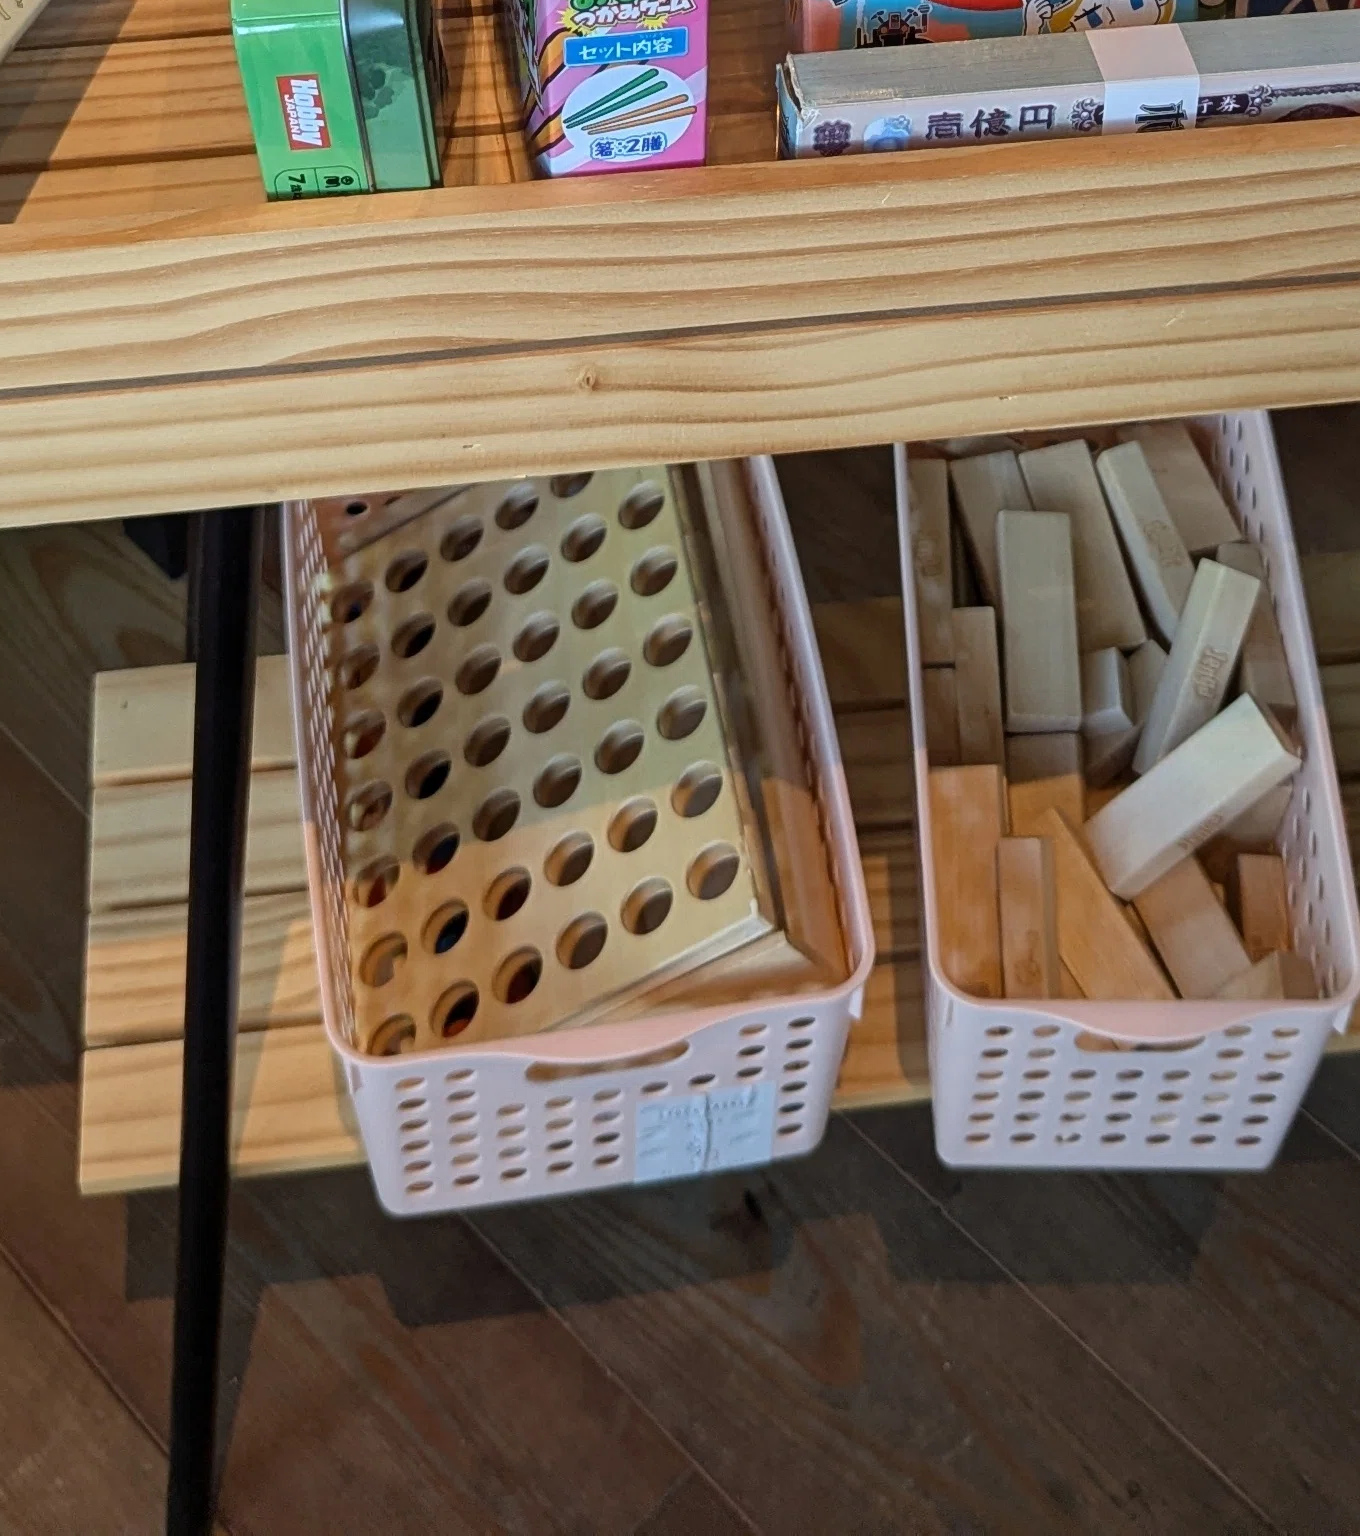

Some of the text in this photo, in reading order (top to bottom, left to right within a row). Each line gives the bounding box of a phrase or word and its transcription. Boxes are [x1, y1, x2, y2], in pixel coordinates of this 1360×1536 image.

[578, 35, 674, 61] セット内容
[283, 95, 302, 137] JAPAN
[290, 76, 327, 150] Hobby
